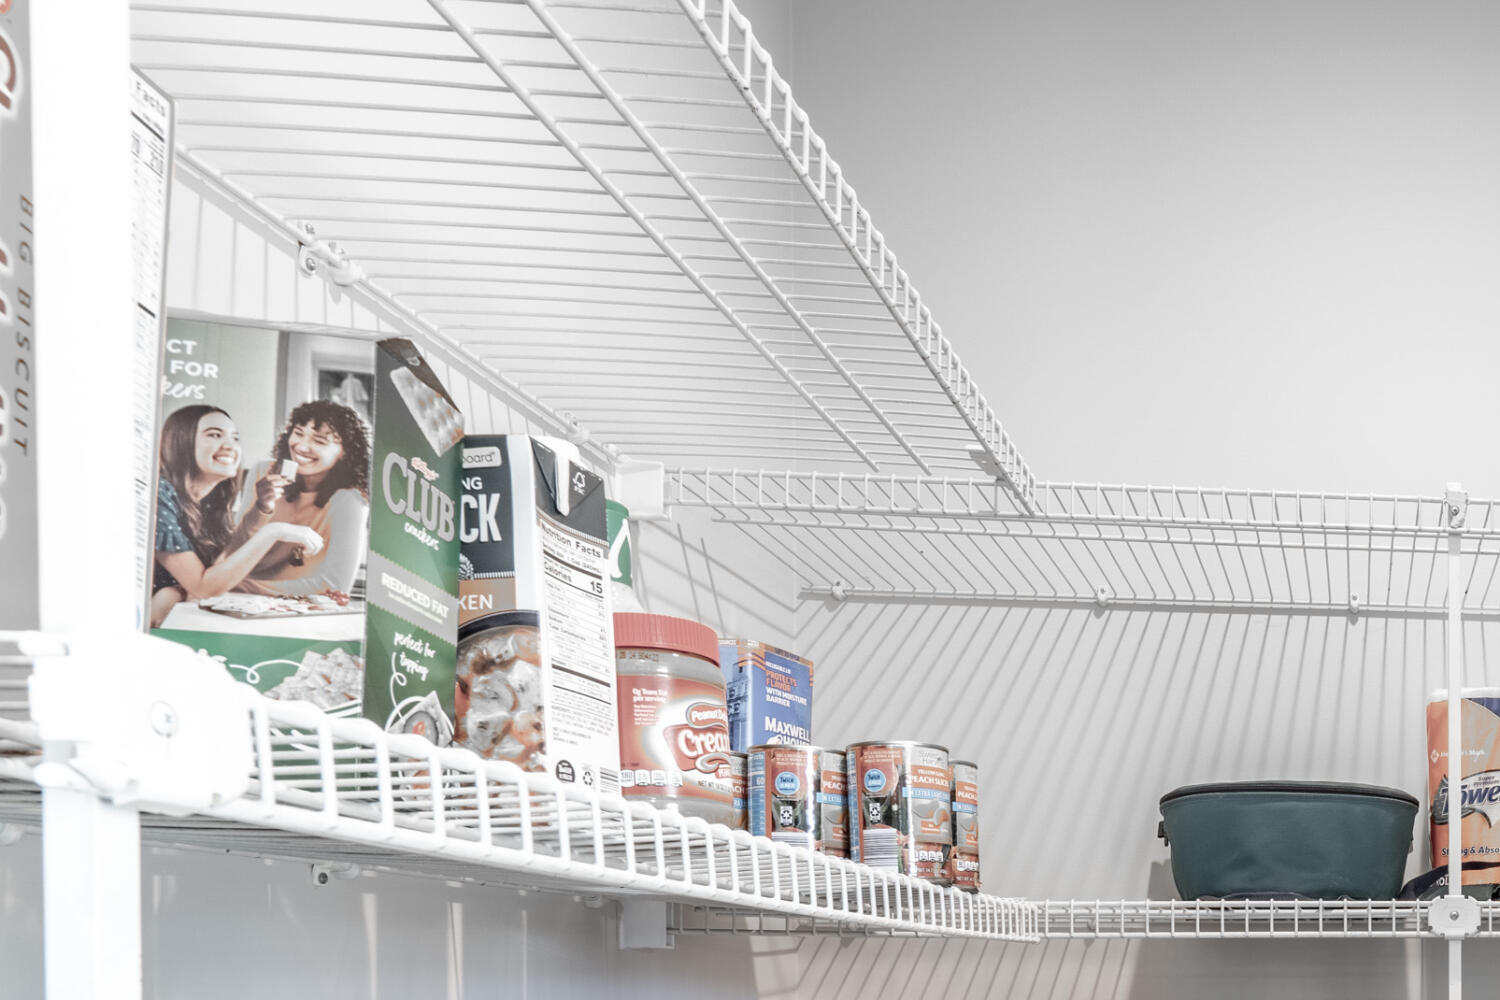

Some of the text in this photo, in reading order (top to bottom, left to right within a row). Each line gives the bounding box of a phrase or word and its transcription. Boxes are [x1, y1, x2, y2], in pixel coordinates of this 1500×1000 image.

[13, 195, 33, 456] BIG BISCUIT
[170, 361, 218, 378] FOR
[382, 452, 455, 541] CLUB
[575, 541, 601, 558] Facts
[590, 580, 603, 594] 15
[431, 598, 449, 618] FAT
[765, 715, 810, 744] MAXWELL
